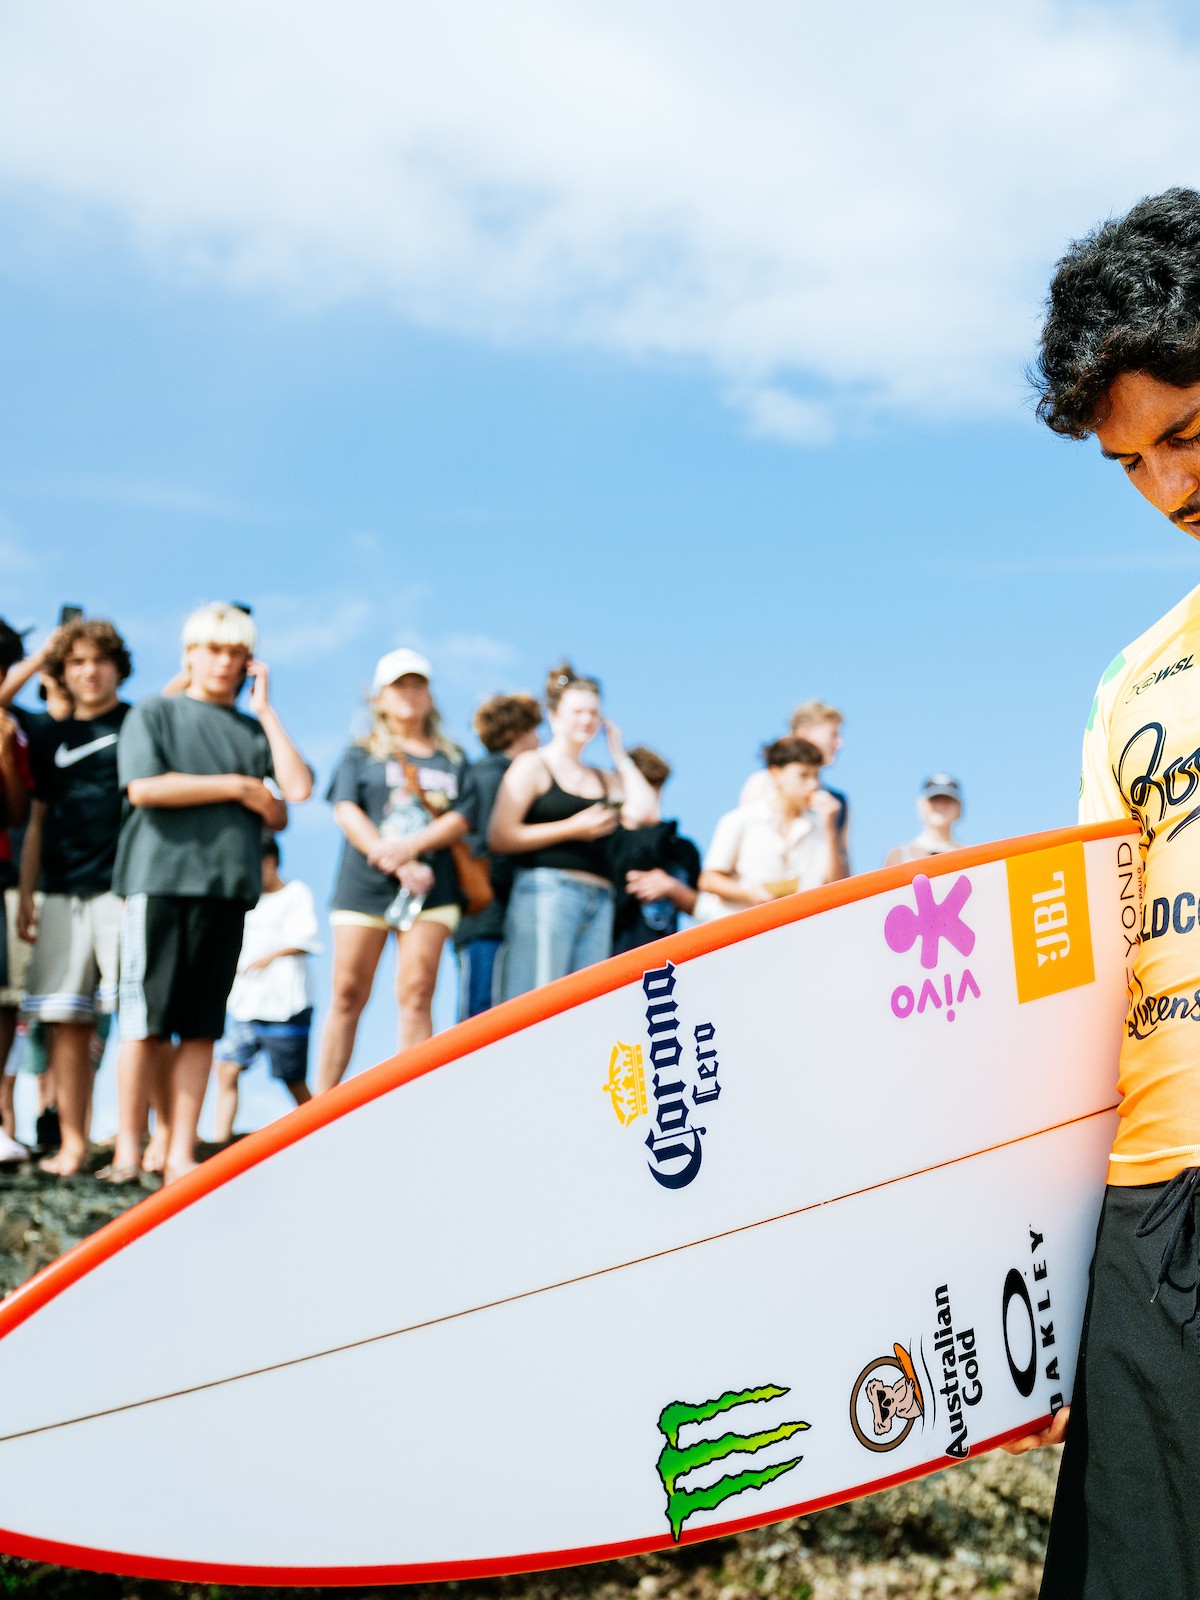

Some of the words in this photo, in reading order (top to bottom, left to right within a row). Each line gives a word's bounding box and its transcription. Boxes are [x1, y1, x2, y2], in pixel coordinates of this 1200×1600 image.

[1154, 653, 1195, 684] WSL
[891, 967, 981, 1023] vivo
[642, 960, 706, 1191] Corona
[692, 1021, 722, 1107] Cero
[1029, 1230, 1064, 1417] OAKLEY
[934, 1283, 970, 1459] Australian
[956, 1327, 983, 1407] Gold
